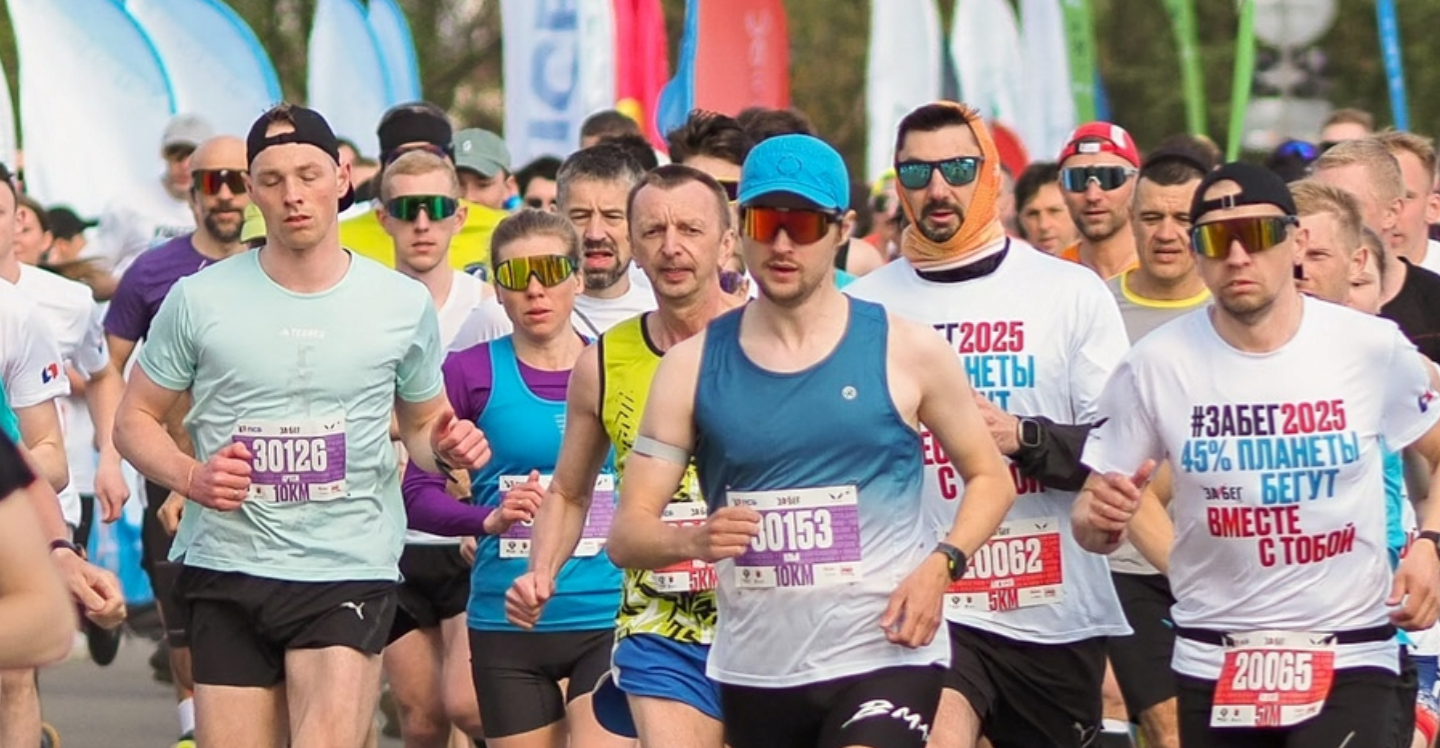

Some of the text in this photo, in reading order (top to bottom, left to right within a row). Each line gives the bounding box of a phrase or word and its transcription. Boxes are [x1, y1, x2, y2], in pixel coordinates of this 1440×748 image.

[1190, 400, 1346, 437] #ЗАБЕГ2025
[252, 438, 327, 473] 30126
[1181, 431, 1360, 472] 45% ПЛАНЕТЫ
[1261, 469, 1340, 504] БЕГУТ
[751, 508, 833, 552] 30153
[1207, 505, 1302, 538] ВМЕСТЕ
[1259, 522, 1355, 567] С ТОБОЙ
[1232, 651, 1313, 691] 20065
